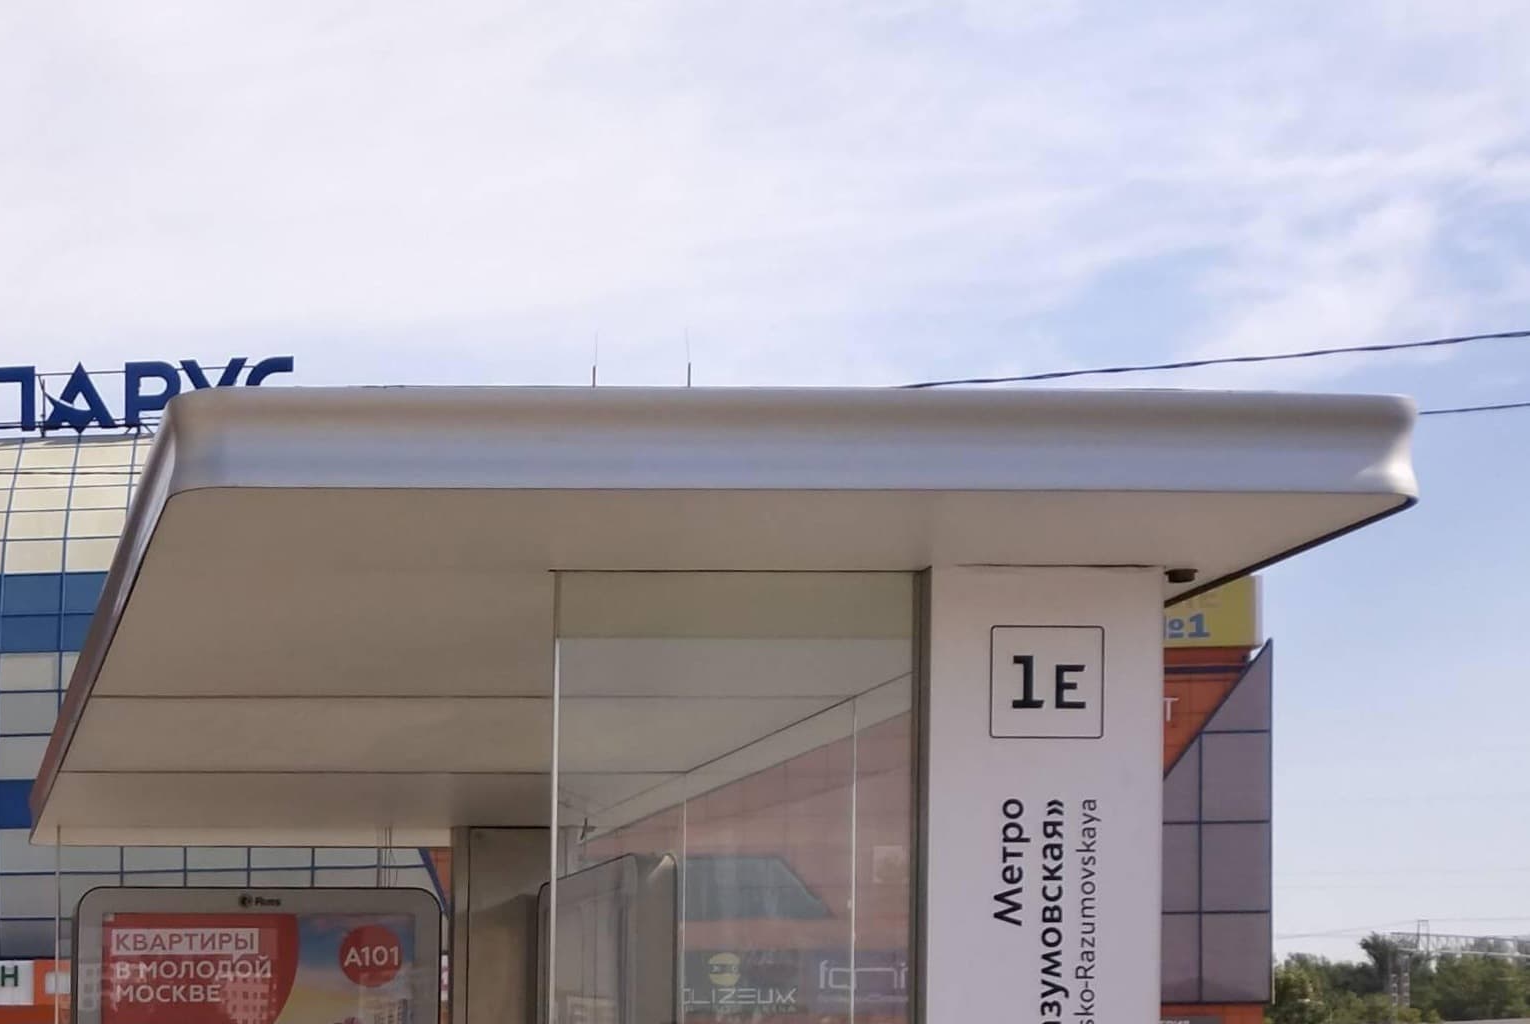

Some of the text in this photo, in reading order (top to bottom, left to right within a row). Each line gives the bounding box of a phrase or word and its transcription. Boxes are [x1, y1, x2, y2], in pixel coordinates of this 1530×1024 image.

[993, 798, 1031, 927] Метро
[115, 932, 255, 951] КВАРТИРЫ
[116, 955, 273, 983] В МОЛОДОЙ
[116, 984, 222, 1003] МОСКВЕ
